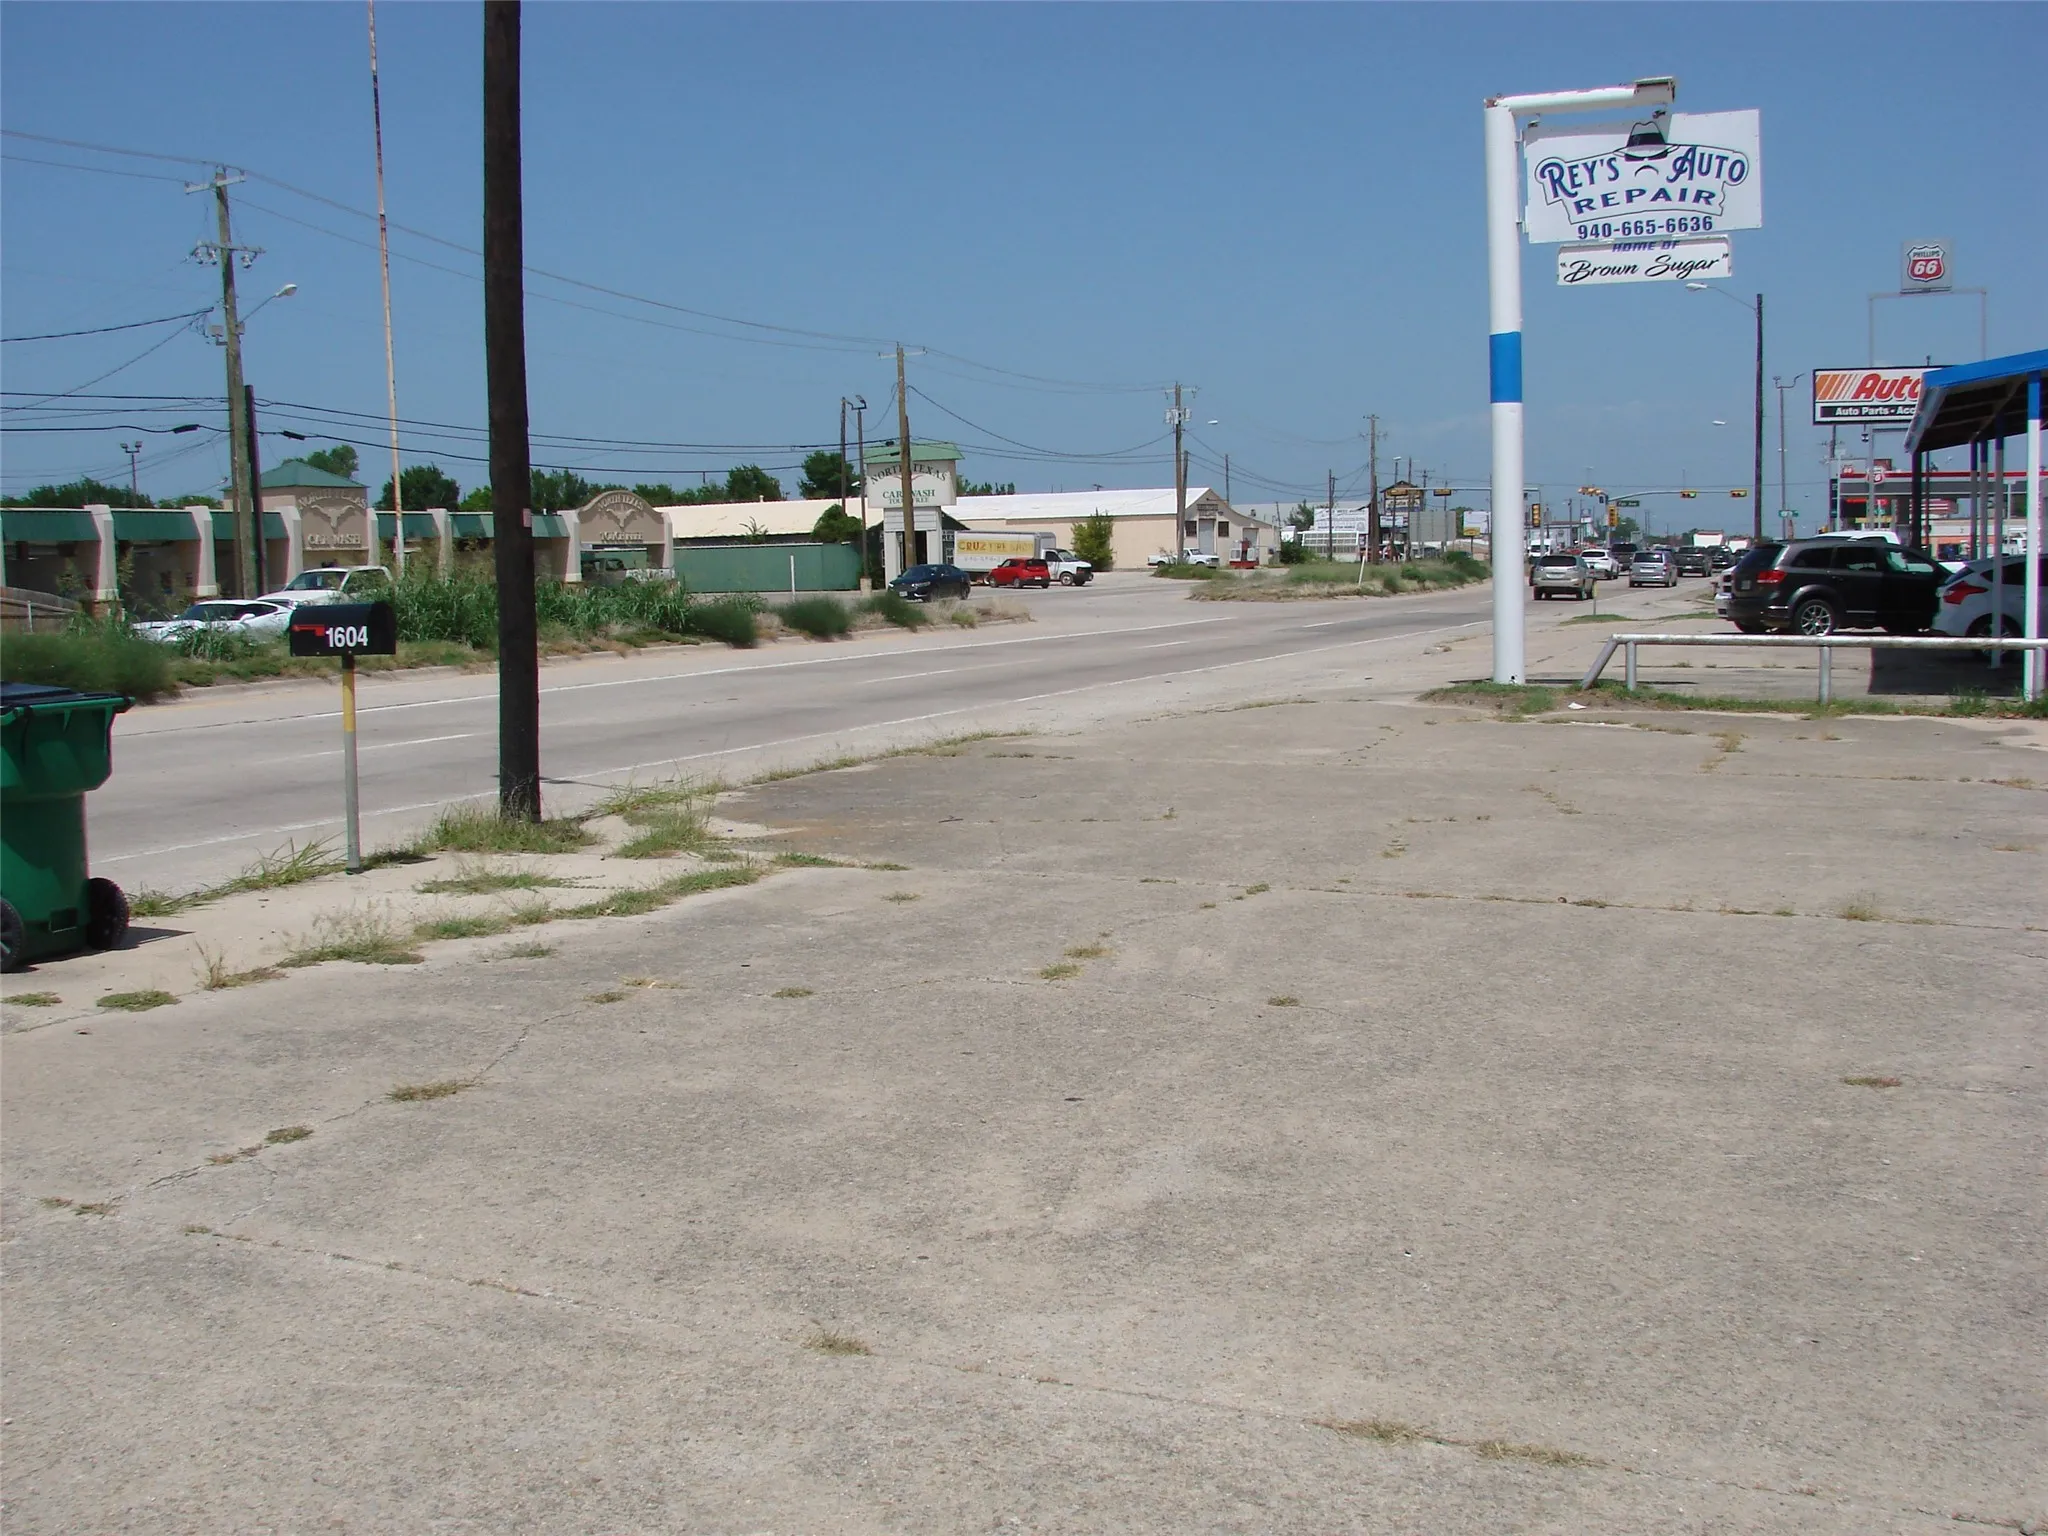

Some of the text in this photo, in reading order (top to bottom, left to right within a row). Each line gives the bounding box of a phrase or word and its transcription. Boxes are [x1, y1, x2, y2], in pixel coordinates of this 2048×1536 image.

[1539, 144, 1746, 199] REY'S AUTO
[1573, 187, 1717, 215] REPAIR
[1577, 215, 1713, 240] 940-665-6636
[1612, 240, 1680, 253] HOME OF
[1913, 260, 1939, 275] 66
[1835, 406, 1860, 417] Auto
[1862, 406, 1889, 416] Parts
[912, 462, 947, 482] TEXAS
[882, 490, 903, 499] CAR
[958, 541, 986, 551] CRUZ
[325, 625, 369, 648] 1604
